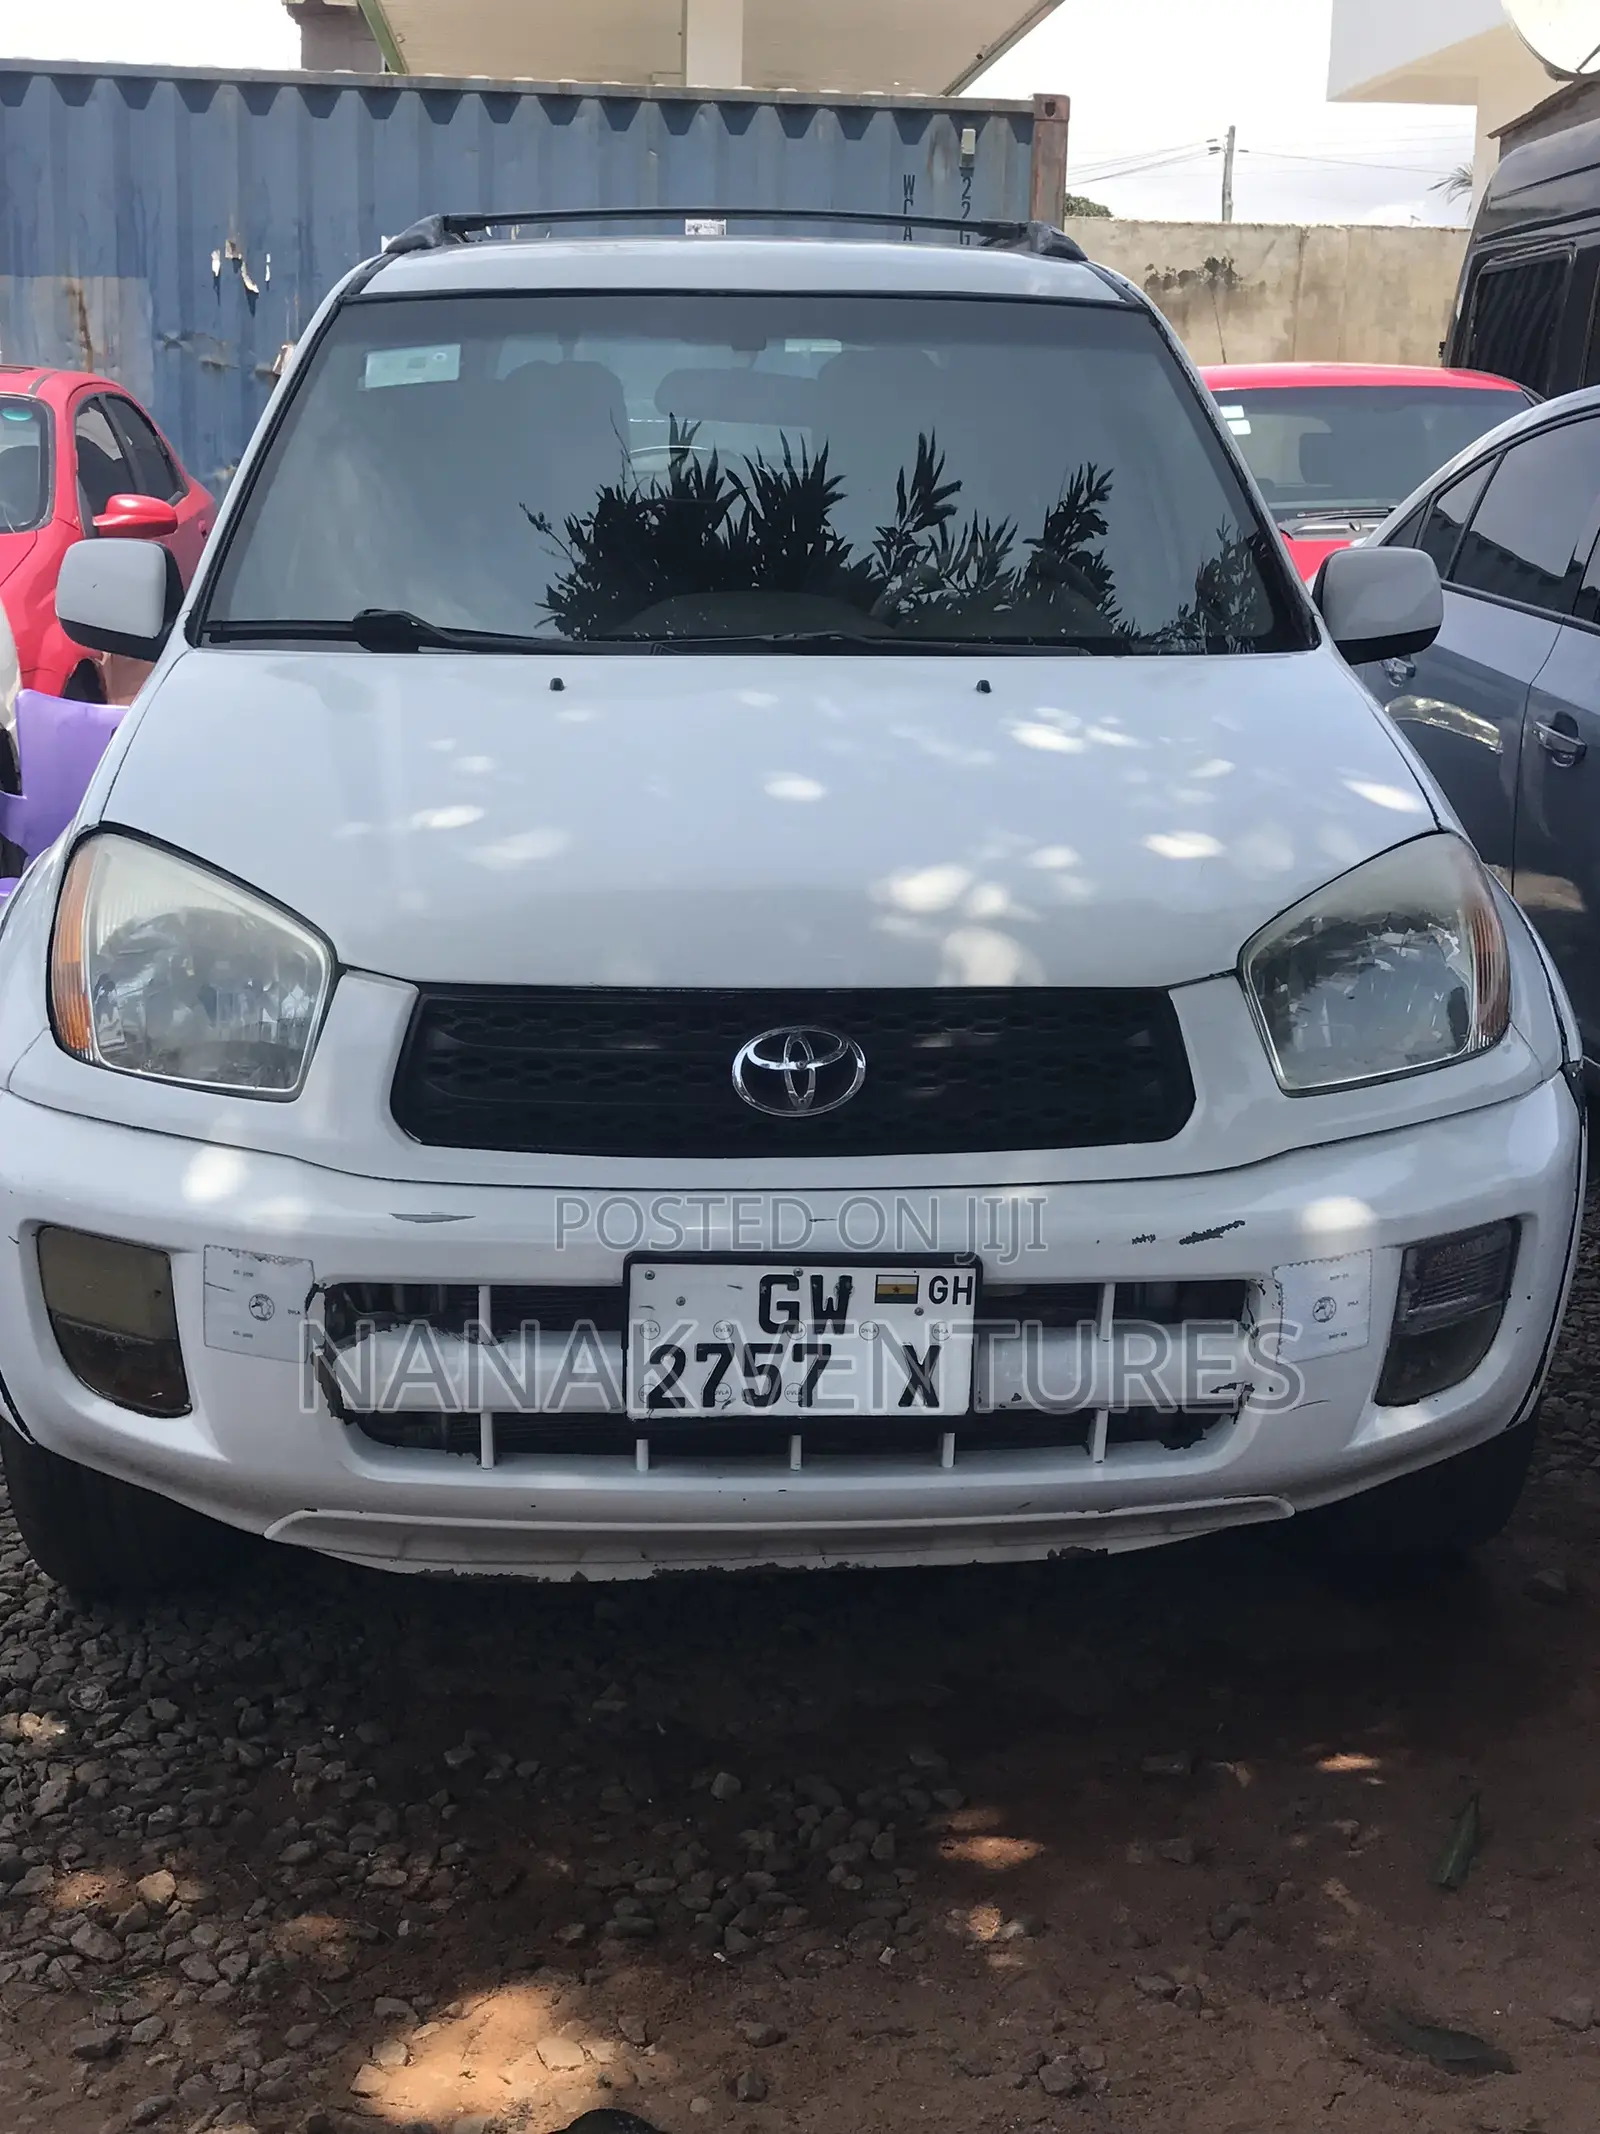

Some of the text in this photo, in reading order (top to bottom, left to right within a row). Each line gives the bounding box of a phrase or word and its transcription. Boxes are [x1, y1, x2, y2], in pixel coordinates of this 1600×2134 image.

[758, 1274, 853, 1335] GW
[928, 1275, 973, 1305] GH
[648, 1343, 943, 1409] 2757 X
